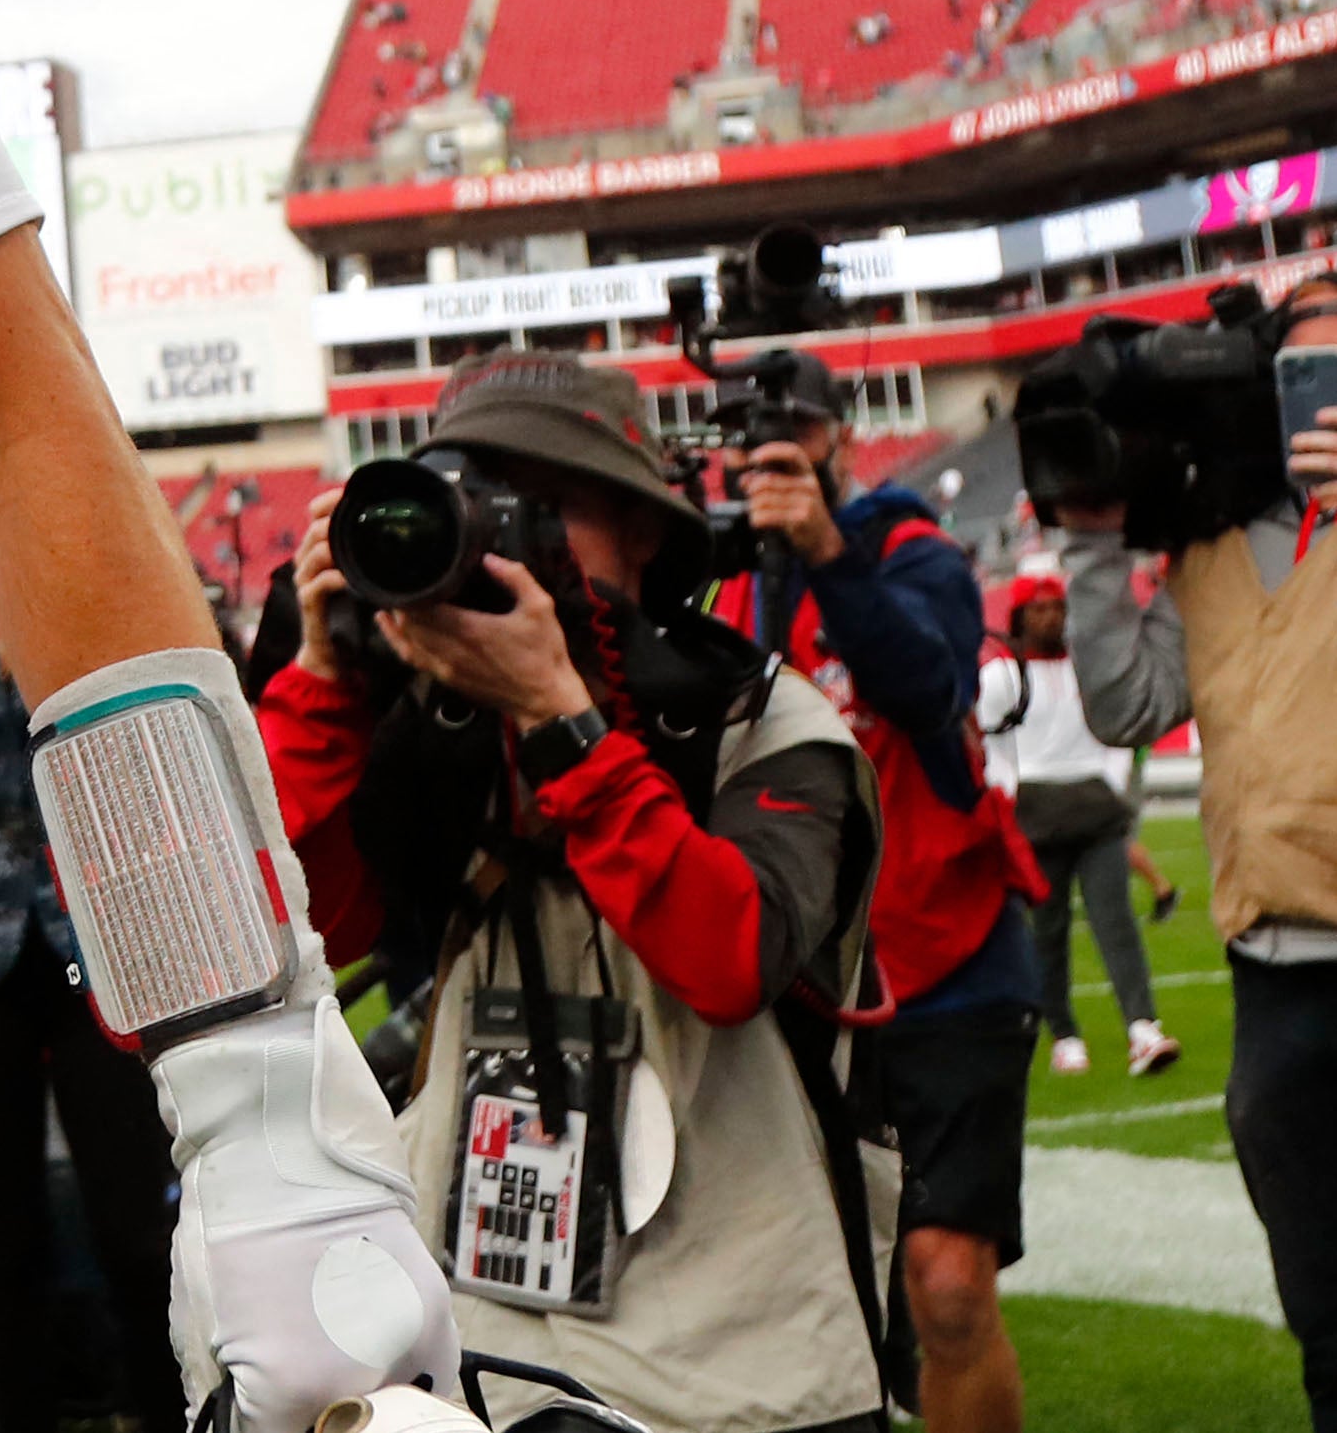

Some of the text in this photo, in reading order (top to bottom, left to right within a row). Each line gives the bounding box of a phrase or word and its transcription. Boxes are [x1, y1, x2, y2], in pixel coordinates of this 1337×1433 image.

[978, 95, 1041, 138] JOHN
[594, 151, 722, 194] BARBER
[96, 251, 284, 309] Frontier
[160, 339, 241, 370] BUD
[144, 369, 255, 404] LIGHT
